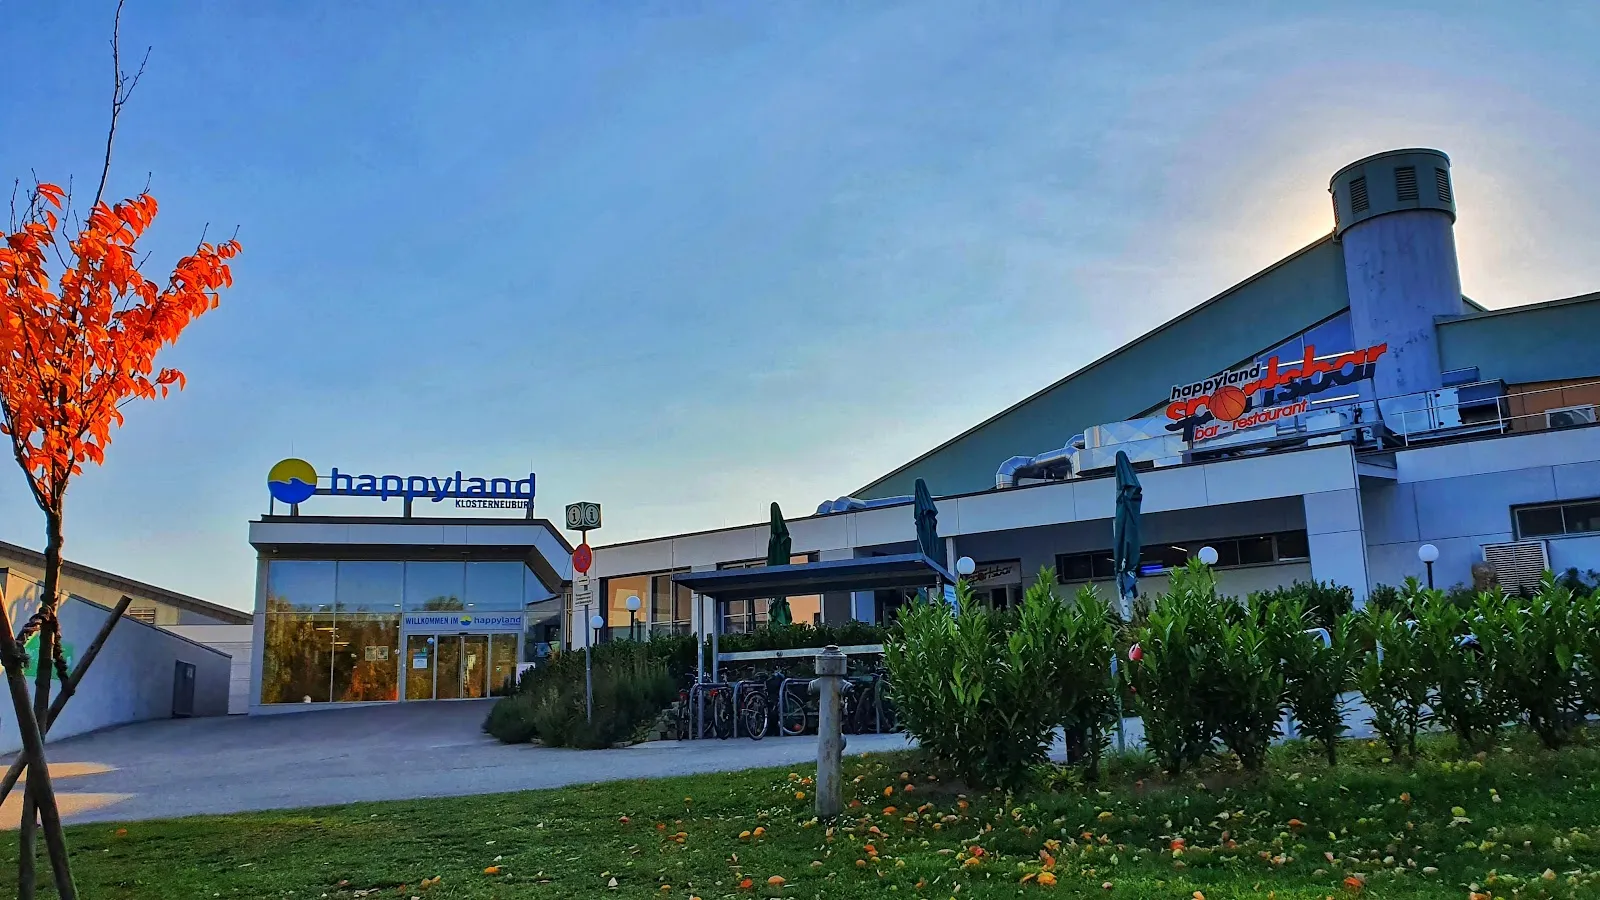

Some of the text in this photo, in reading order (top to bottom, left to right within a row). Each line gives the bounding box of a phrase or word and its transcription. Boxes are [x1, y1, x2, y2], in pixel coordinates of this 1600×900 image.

[1171, 364, 1261, 399] happyland
[1194, 425, 1220, 440] bar
[1232, 399, 1307, 430] restaurant
[331, 467, 536, 502] happyland
[455, 499, 534, 509] KLOSTERNEUBUR
[405, 616, 521, 625] WILLKOMMEN IM happyland
